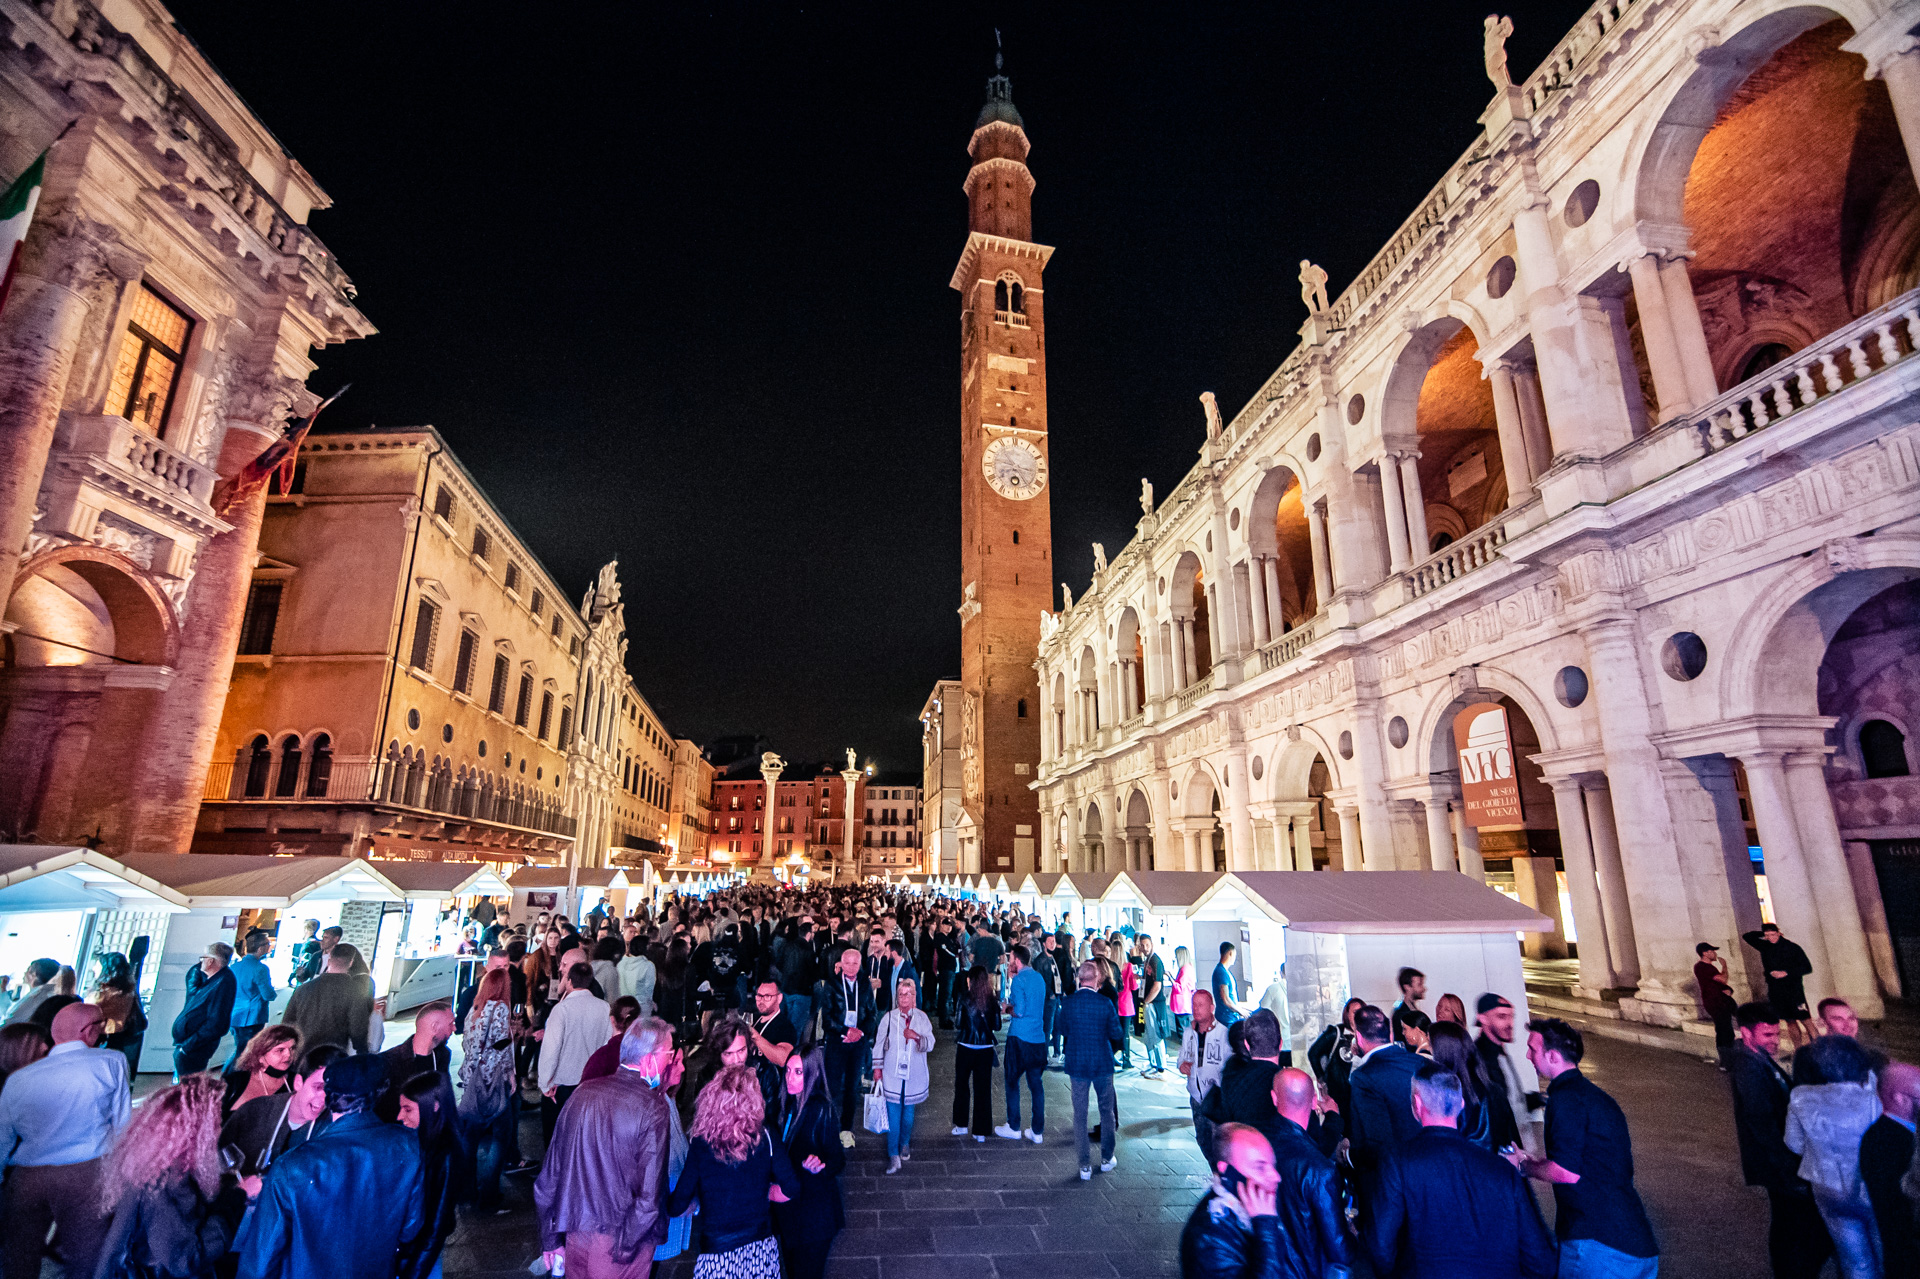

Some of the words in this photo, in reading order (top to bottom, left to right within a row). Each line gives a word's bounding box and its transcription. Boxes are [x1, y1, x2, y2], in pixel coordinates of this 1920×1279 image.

[1490, 786, 1516, 797] MUSEO
[1467, 800, 1482, 810] DEL
[1482, 797, 1517, 808] GIOIELLO
[1486, 807, 1518, 817] VICENZA
[410, 849, 433, 859] TESSUTI
